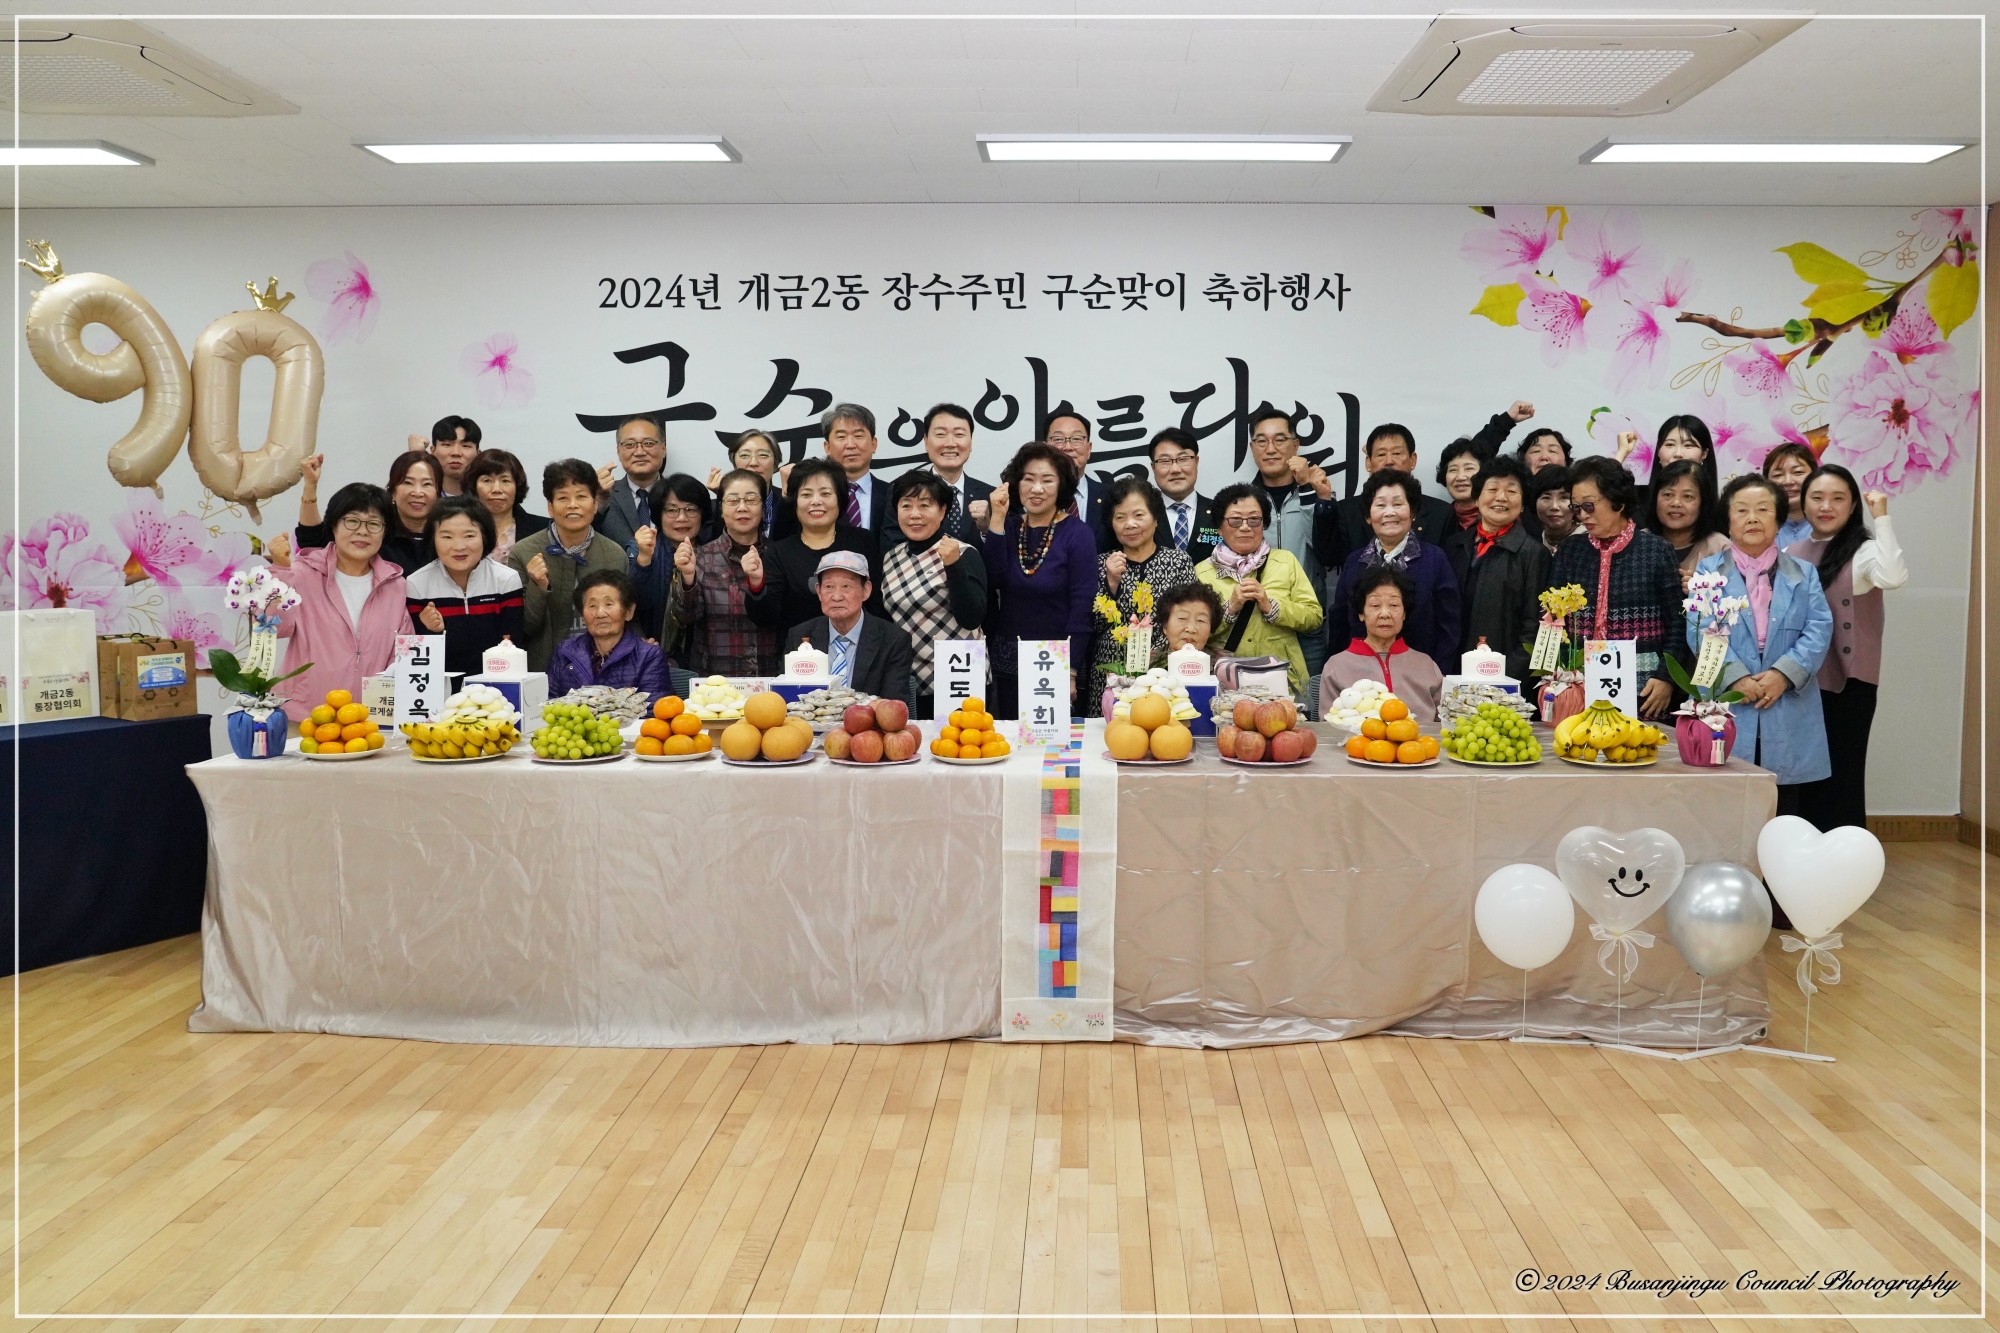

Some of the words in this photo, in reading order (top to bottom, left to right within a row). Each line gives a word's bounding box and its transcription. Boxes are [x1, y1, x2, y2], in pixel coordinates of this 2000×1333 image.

[598, 272, 721, 310] 2024년
[738, 272, 869, 311] 개금2동
[881, 272, 1027, 311] 장수주민
[1042, 272, 1186, 311] 구순맞이
[1202, 272, 1352, 311] 축하행사
[34, 699, 82, 712] 통장협의회
[39, 688, 74, 700] 개금2동
[408, 646, 430, 719] 김정옥
[948, 652, 971, 711] 신도
[1033, 650, 1055, 725] 유옥희
[1600, 650, 1622, 712] 이정
[366, 706, 394, 718] 르게살
